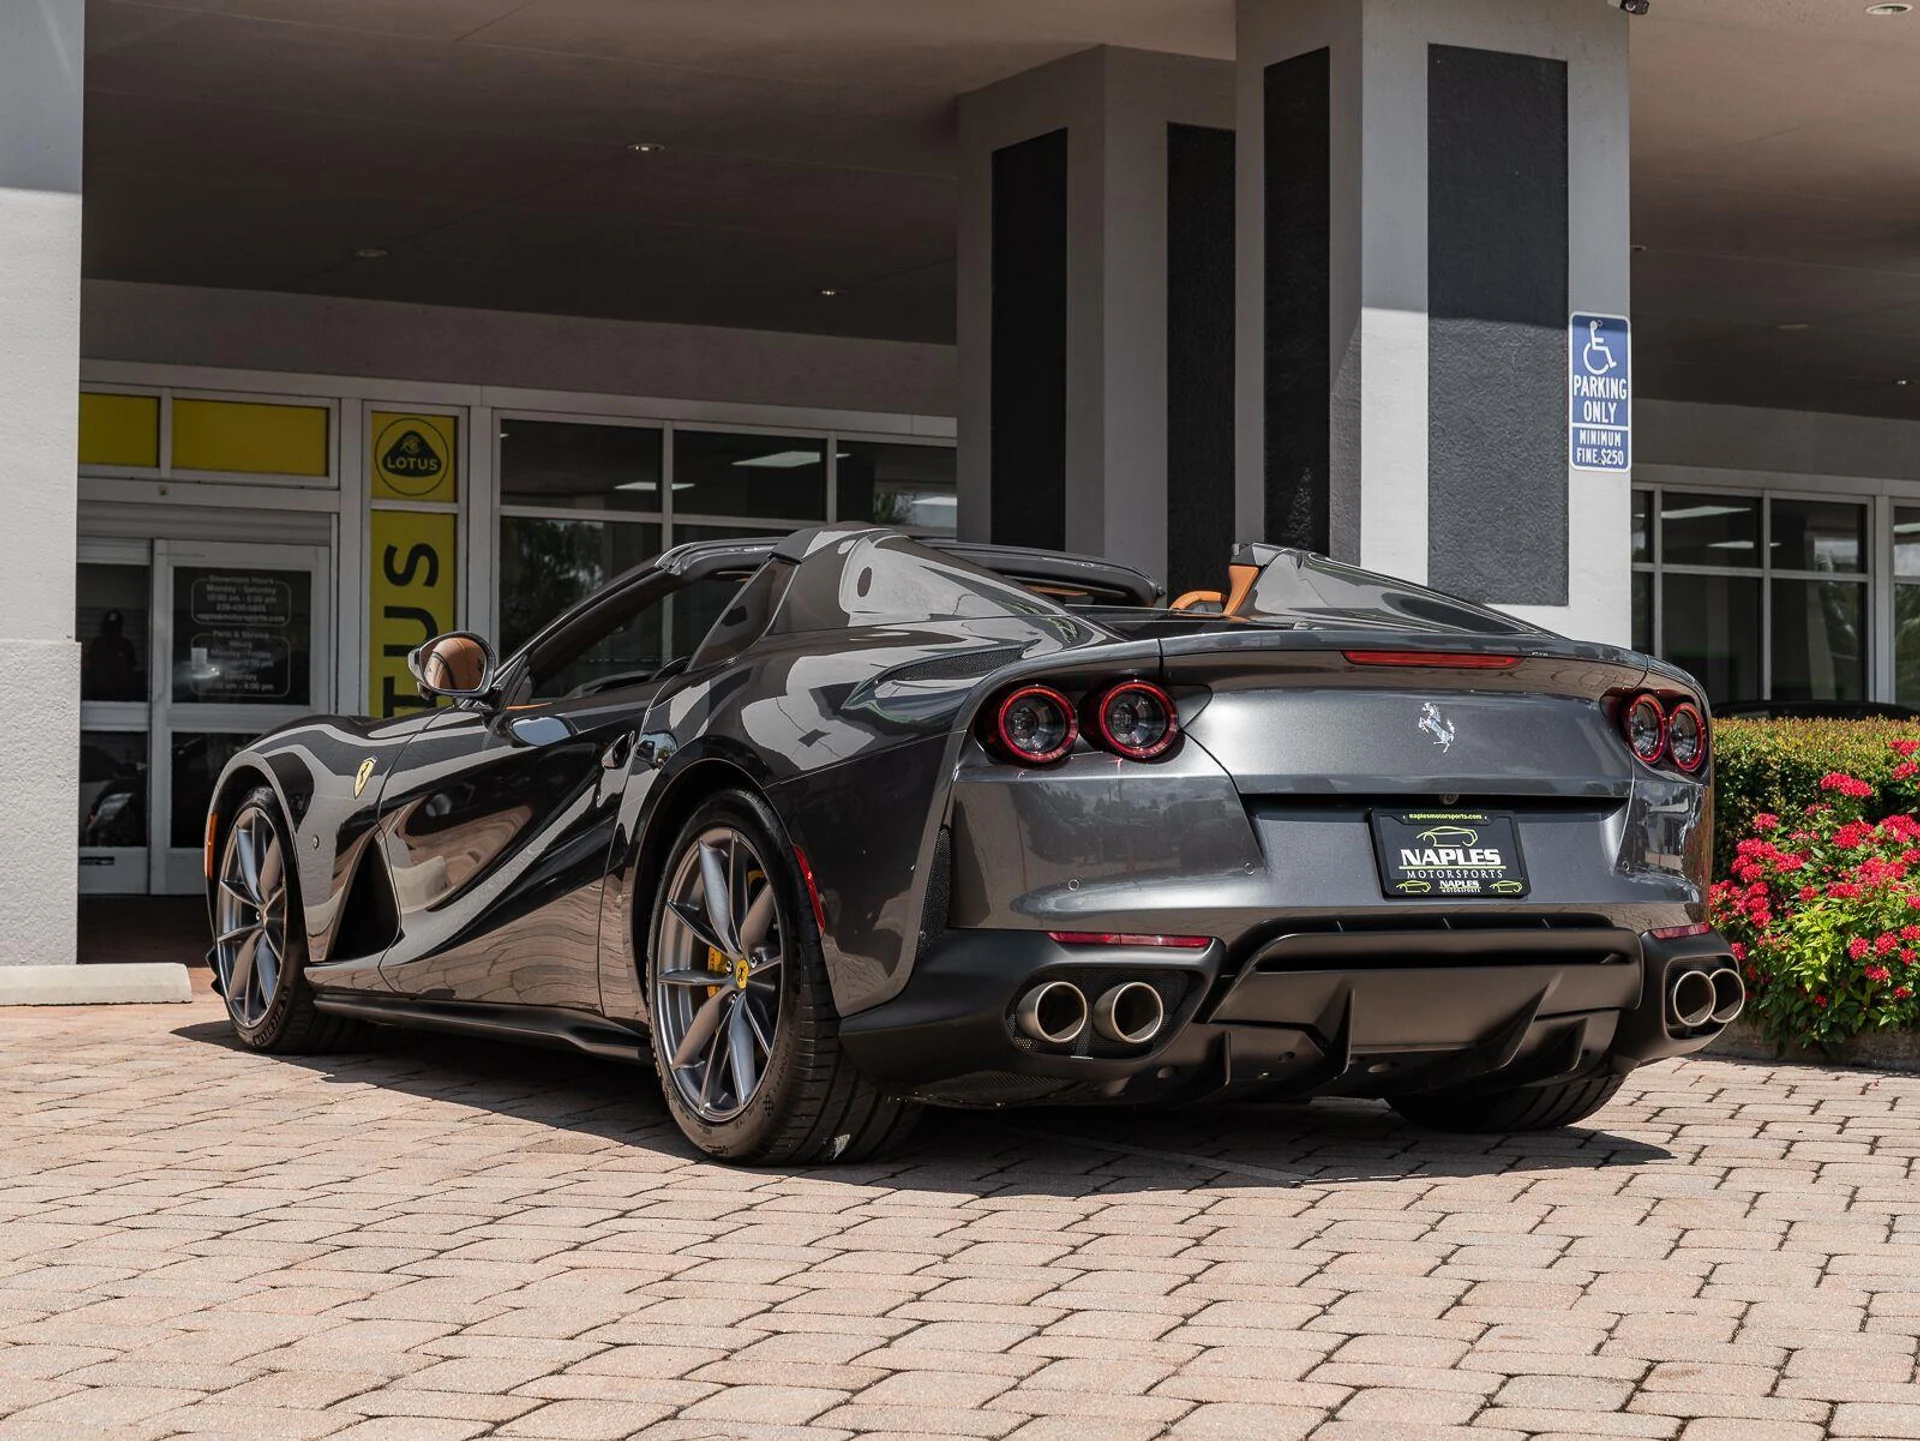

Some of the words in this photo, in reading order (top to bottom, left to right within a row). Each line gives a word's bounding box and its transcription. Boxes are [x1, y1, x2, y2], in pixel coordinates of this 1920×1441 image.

[1573, 374, 1627, 400] PARKING
[1583, 400, 1617, 423] ONLY
[1579, 429, 1621, 447] MINIMUM
[387, 456, 438, 471] LOTUS
[1576, 447, 1599, 463] FINE
[1600, 448, 1624, 466] $250
[1400, 848, 1501, 866] NAPLES
[1406, 870, 1503, 879] MOTORSPORTS
